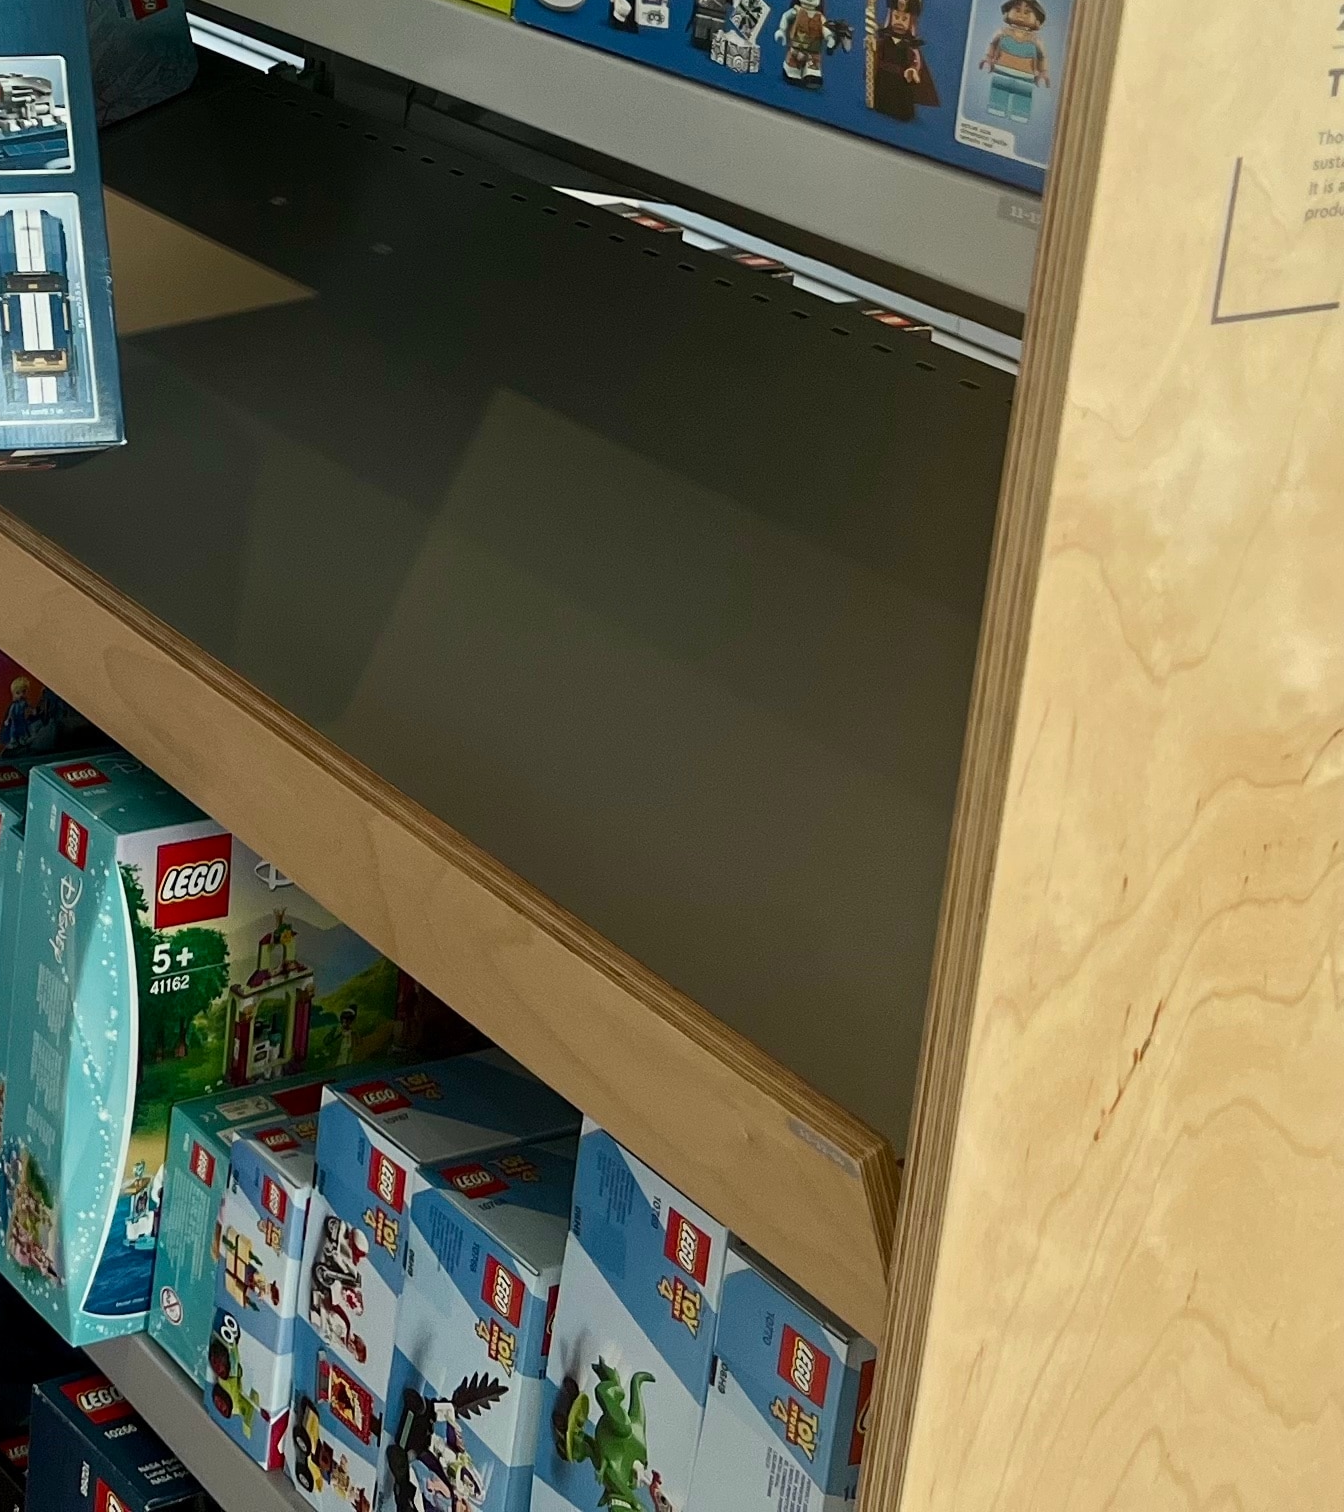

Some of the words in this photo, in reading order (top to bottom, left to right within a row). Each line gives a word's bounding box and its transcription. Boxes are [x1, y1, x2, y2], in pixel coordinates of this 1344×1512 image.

[1323, 180, 1334, 194] is
[64, 767, 101, 784] LEGO
[65, 818, 82, 864] LEGO
[159, 861, 229, 904] LEGO
[55, 874, 83, 964] Disney
[152, 944, 195, 975] 5+
[150, 976, 190, 996] 41162
[361, 1088, 399, 1106] LEGO
[265, 1133, 290, 1146] LEGO
[196, 1146, 209, 1181] LEGO
[378, 1154, 395, 1206] LEGO
[455, 1171, 490, 1190] LEGO
[269, 1179, 282, 1217] LEGO
[363, 1207, 378, 1231] 4
[383, 1217, 400, 1262] TOY
[678, 1219, 698, 1273] LEGO
[494, 1267, 513, 1316] LEGO
[657, 1274, 673, 1300] 4
[673, 1278, 684, 1321] STORY
[475, 1317, 490, 1343] 4
[682, 1287, 702, 1340] TOY
[764, 1311, 775, 1346] 10770
[490, 1318, 499, 1360] STORY
[497, 1331, 516, 1378] TOY
[791, 1339, 815, 1393] LEGO
[770, 1396, 787, 1425] 4
[786, 1397, 800, 1445] STORY
[104, 1423, 138, 1440] 10266
[798, 1410, 819, 1463] TOY
